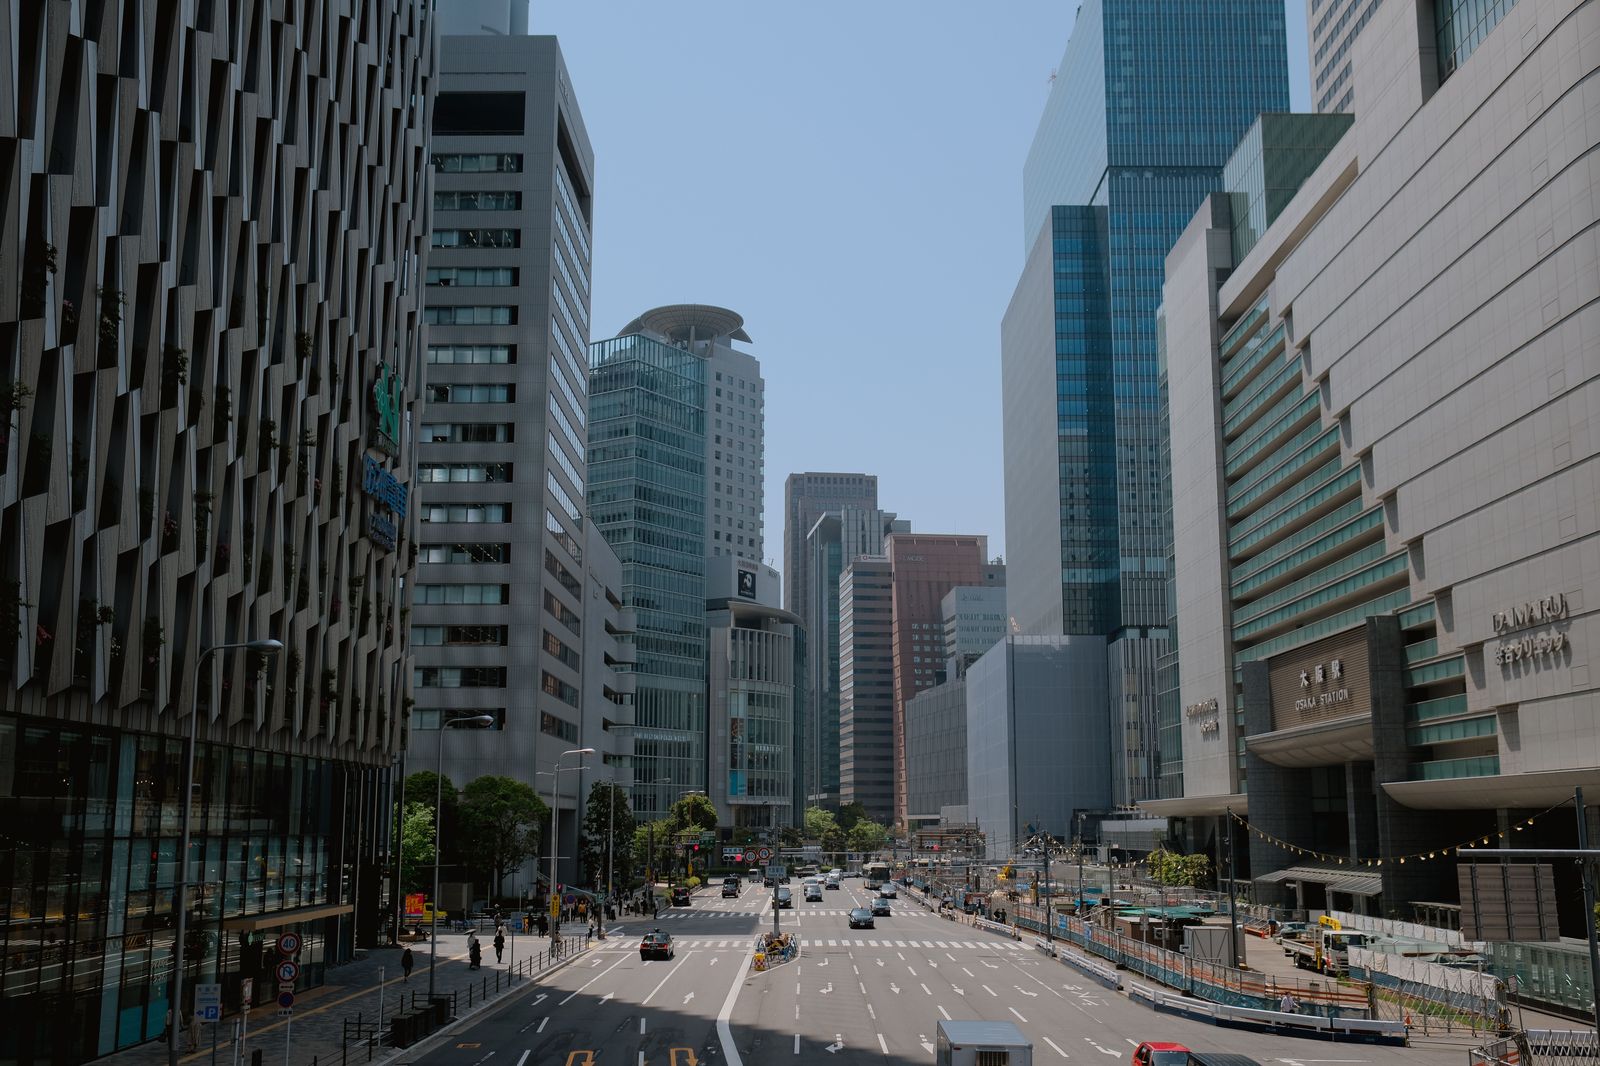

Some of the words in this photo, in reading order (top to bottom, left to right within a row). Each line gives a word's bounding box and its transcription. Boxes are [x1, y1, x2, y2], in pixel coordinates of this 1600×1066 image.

[1300, 659, 1341, 688] 大阪駅
[1295, 697, 1317, 711] OSAKA
[1320, 688, 1349, 705] STATION
[283, 938, 296, 949] 40
[208, 1007, 216, 1018] P
